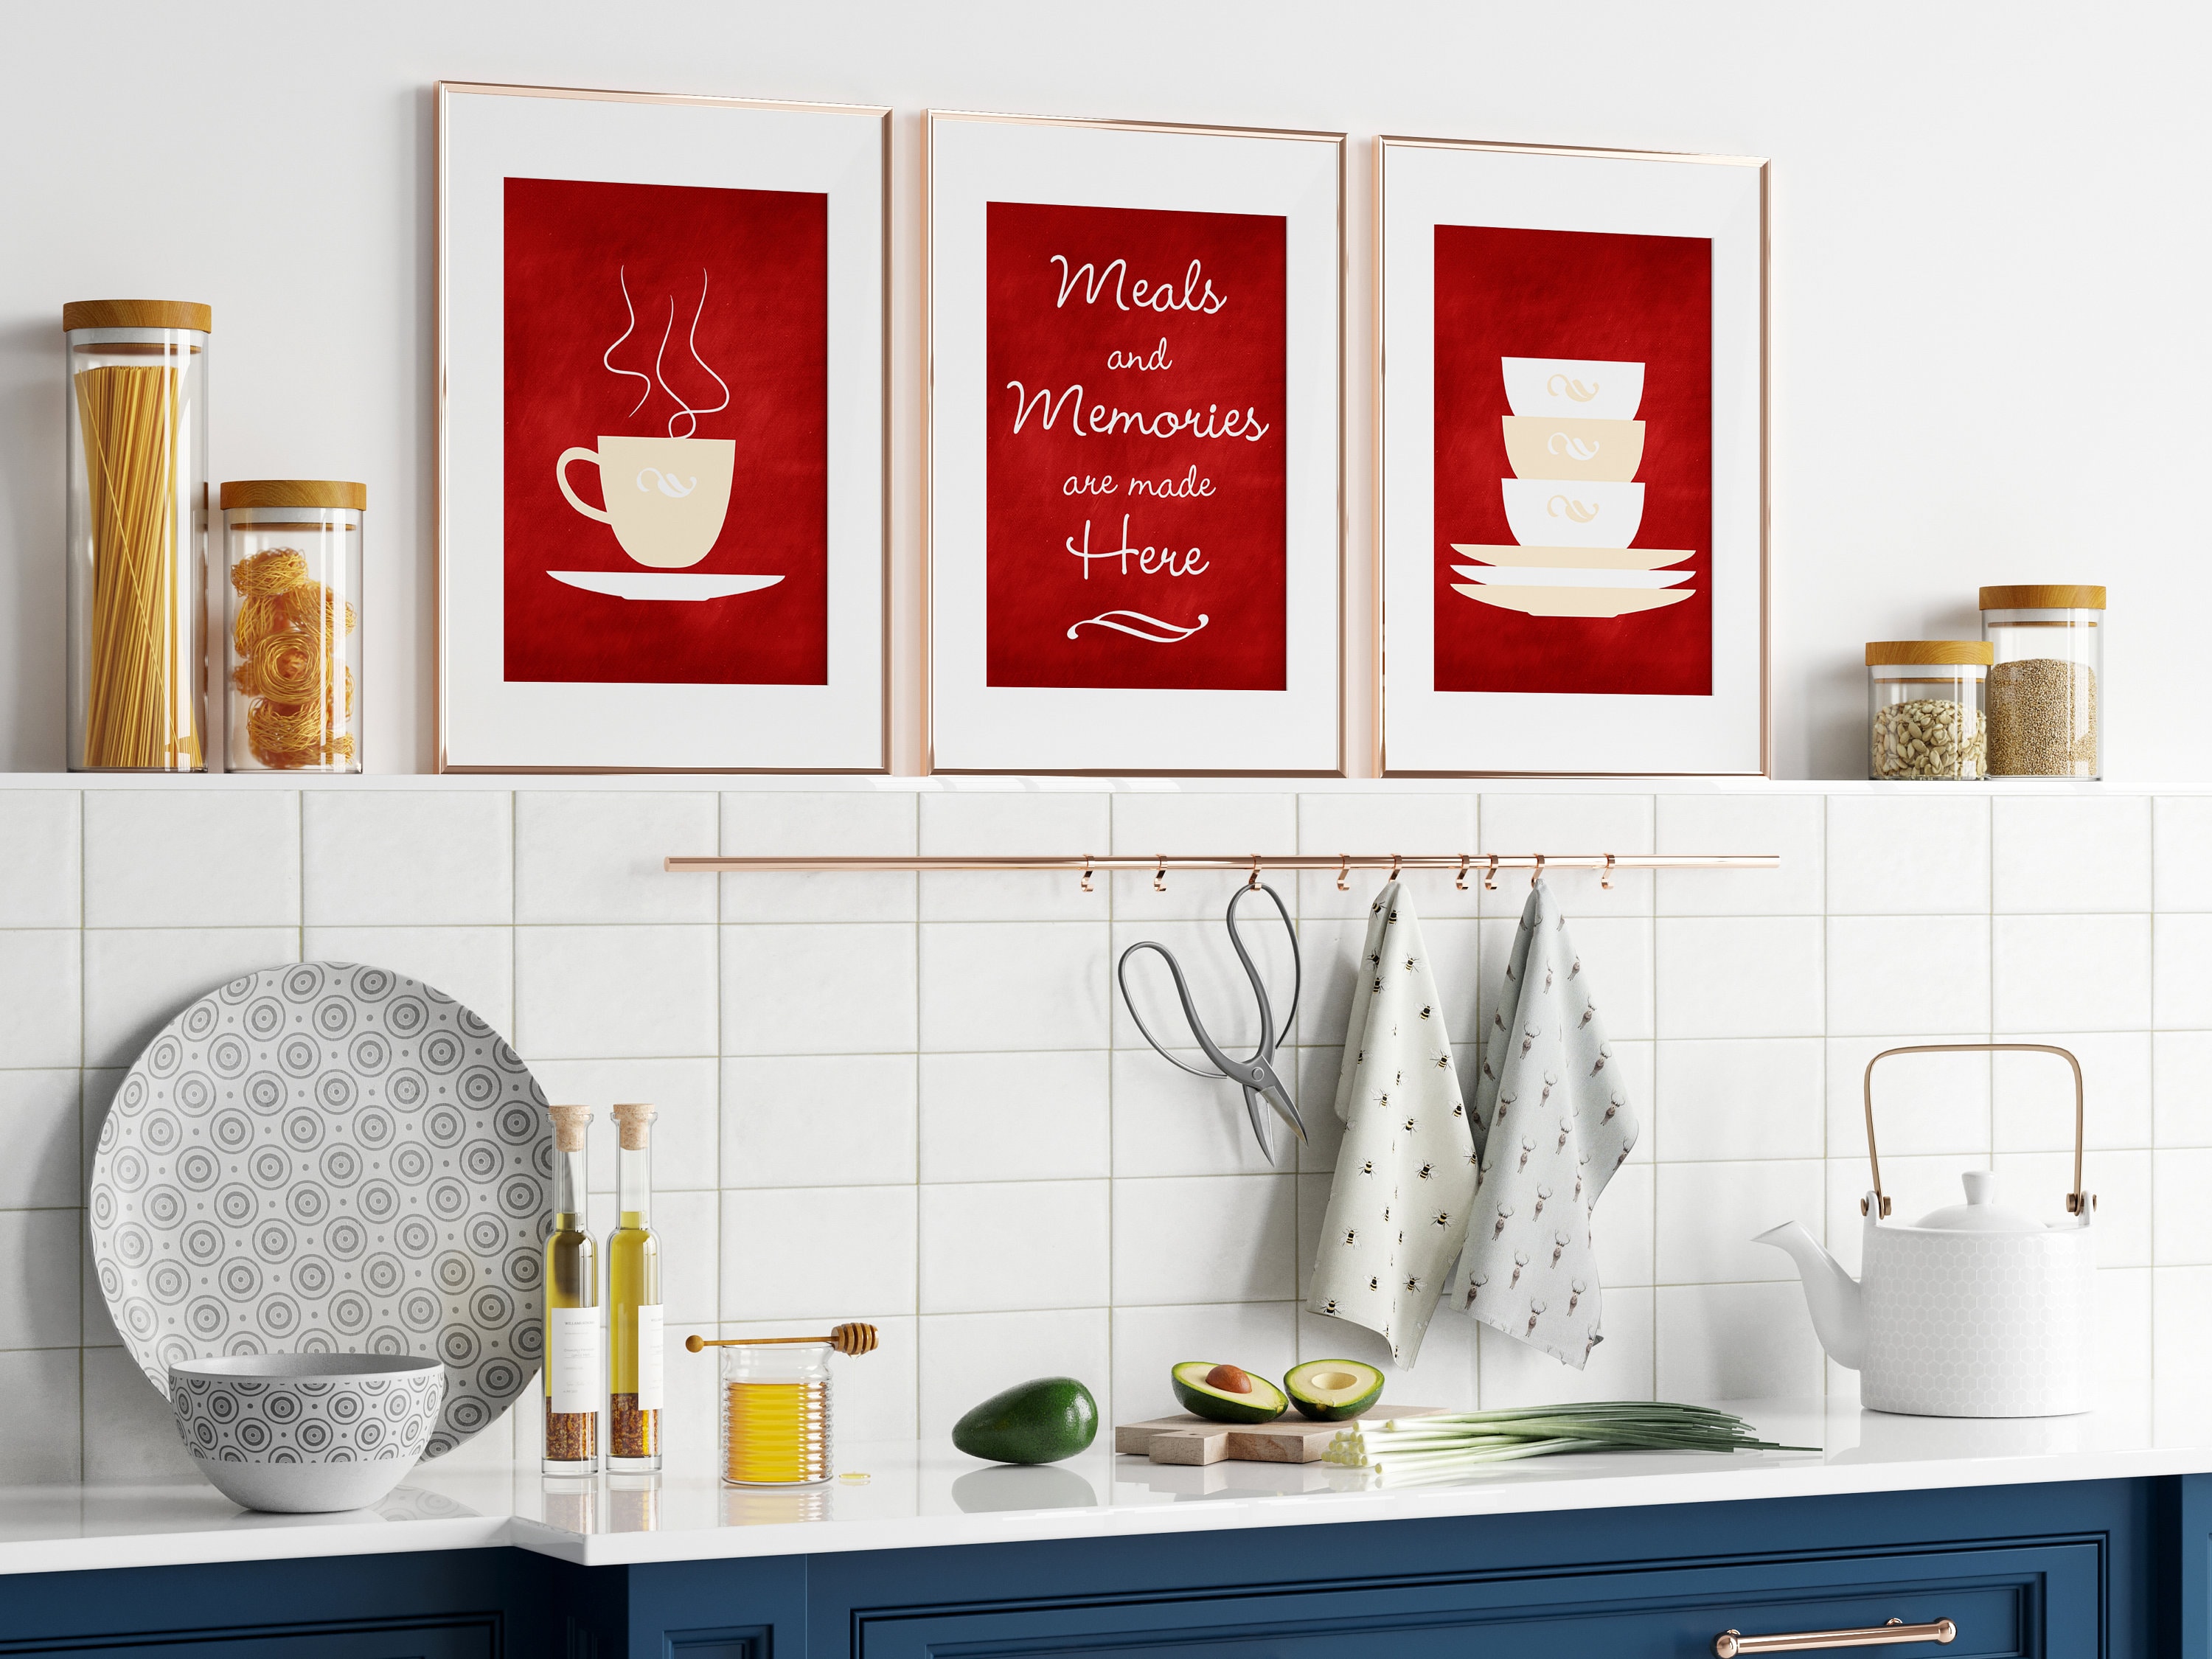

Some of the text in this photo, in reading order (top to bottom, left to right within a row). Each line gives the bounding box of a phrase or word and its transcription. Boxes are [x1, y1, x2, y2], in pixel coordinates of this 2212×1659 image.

[1050, 254, 1228, 314] Meals
[1107, 337, 1173, 371] and
[1006, 380, 1270, 442] Memories
[1062, 464, 1217, 498] are made
[1065, 513, 1210, 580] Here
